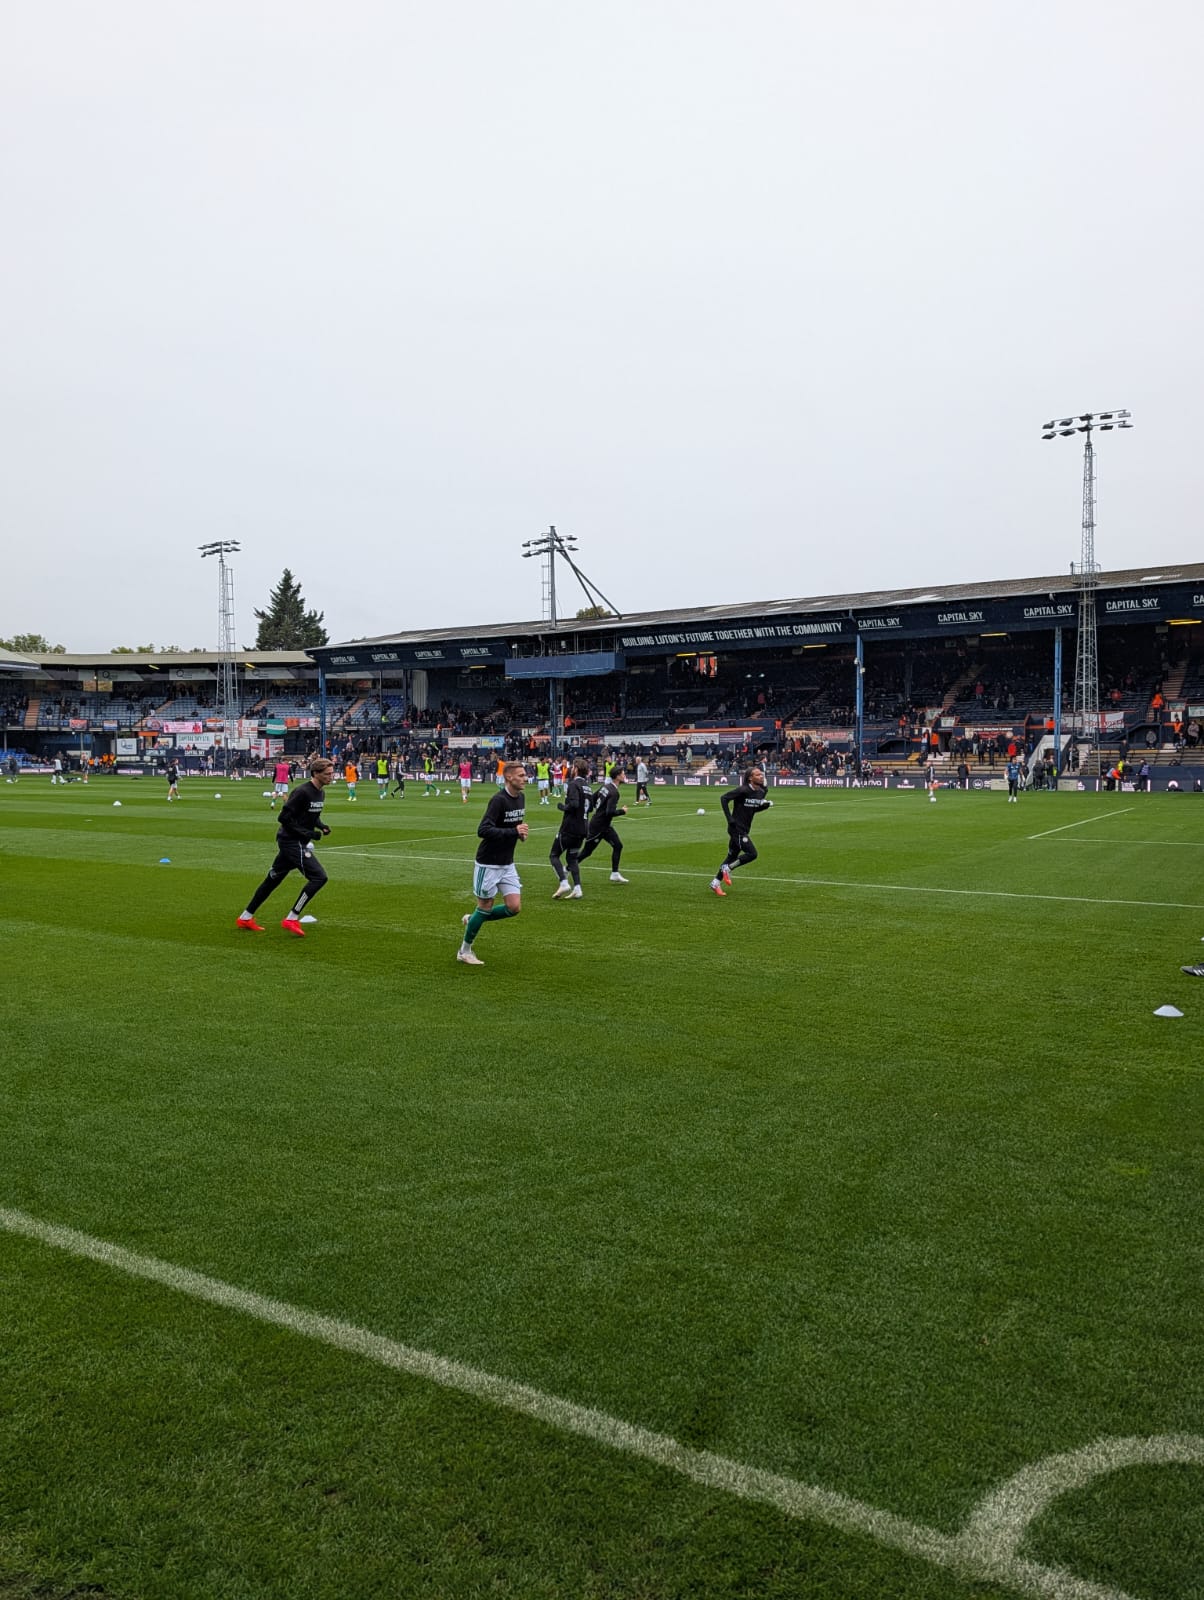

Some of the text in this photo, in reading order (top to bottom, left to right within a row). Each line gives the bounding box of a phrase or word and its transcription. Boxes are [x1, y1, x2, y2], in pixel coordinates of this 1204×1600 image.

[1106, 598, 1159, 610] CAPITAL SKY
[1023, 604, 1073, 617] CAPITAL SKY
[857, 617, 901, 628] CAPITAL SKY
[938, 611, 983, 623] CAPITAL SKY
[622, 622, 842, 647] BUILDING LUTON'S FUTURE TOGETHER WITH THE COMMUNITY
